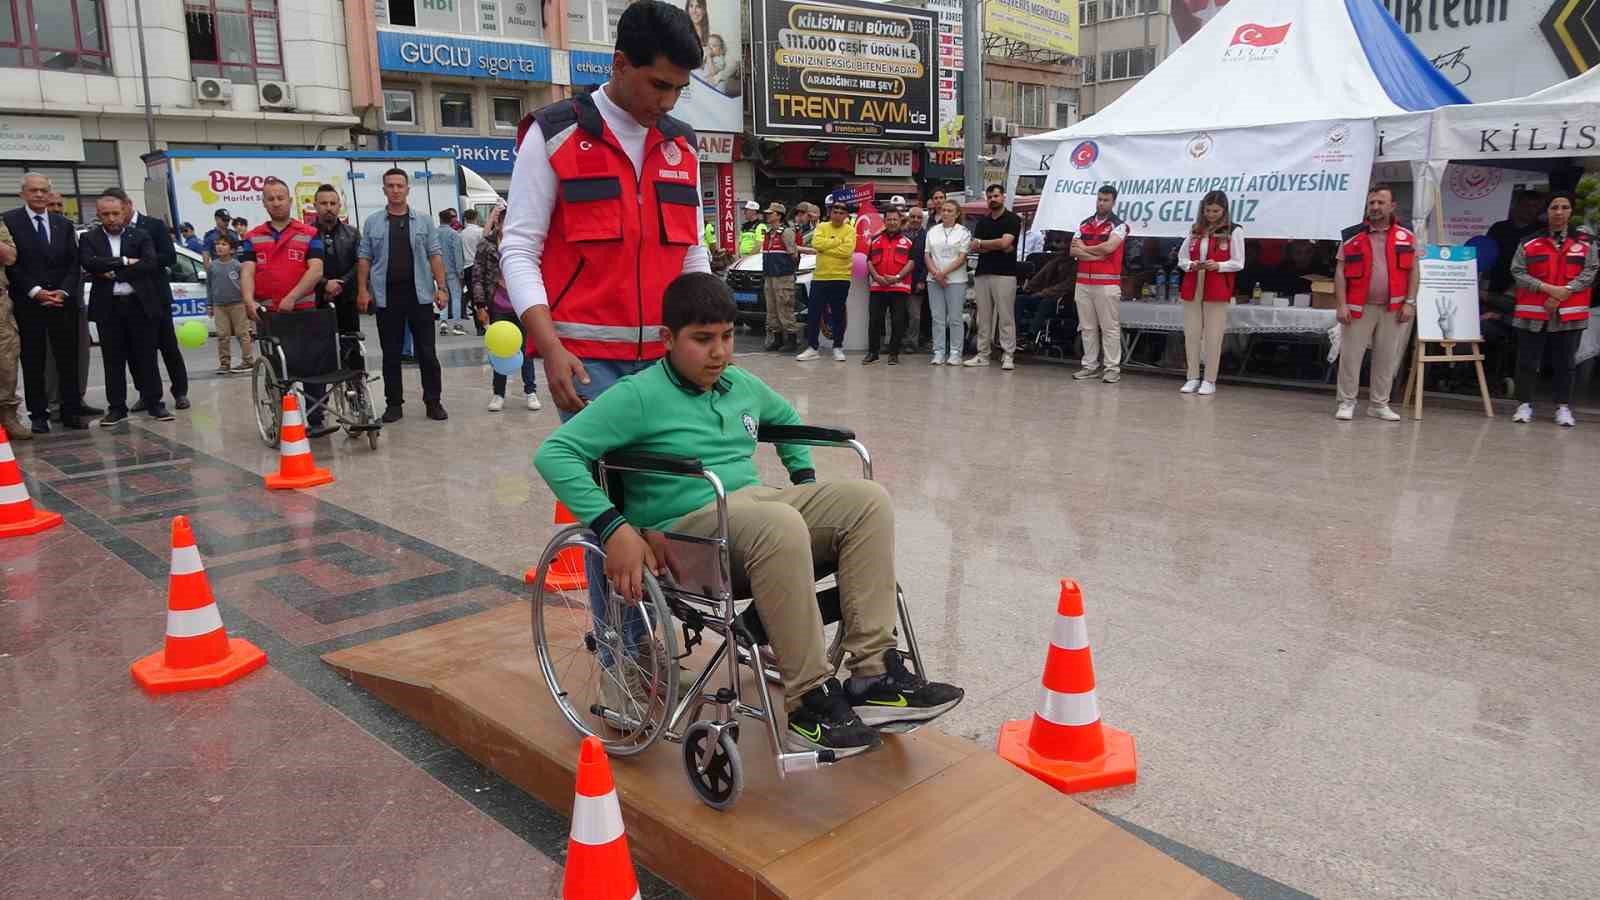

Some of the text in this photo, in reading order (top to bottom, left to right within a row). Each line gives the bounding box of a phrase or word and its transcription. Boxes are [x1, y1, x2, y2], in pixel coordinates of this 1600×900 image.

[848, 20, 863, 32] EN
[866, 20, 905, 37] BÜYÜK
[401, 42, 535, 75] GÜÇLÜ sigorta
[785, 34, 916, 59] 111.000 ÇEŞİT ÜRÜN İLE
[889, 64, 917, 74] KADAR
[860, 80, 877, 89] HER
[774, 94, 854, 120] TRENT
[699, 136, 732, 153] ANE
[1480, 120, 1596, 152] KİLİS
[858, 151, 910, 165] ECZANE
[1055, 180, 1097, 195] ENGEL
[1186, 172, 1246, 193] EMPATİ
[1246, 170, 1350, 192] ATÖLYESİNE
[725, 176, 734, 242] ECZANE
[1117, 194, 1259, 228] HOŞ GELİZ
[171, 300, 207, 315] OLİS
